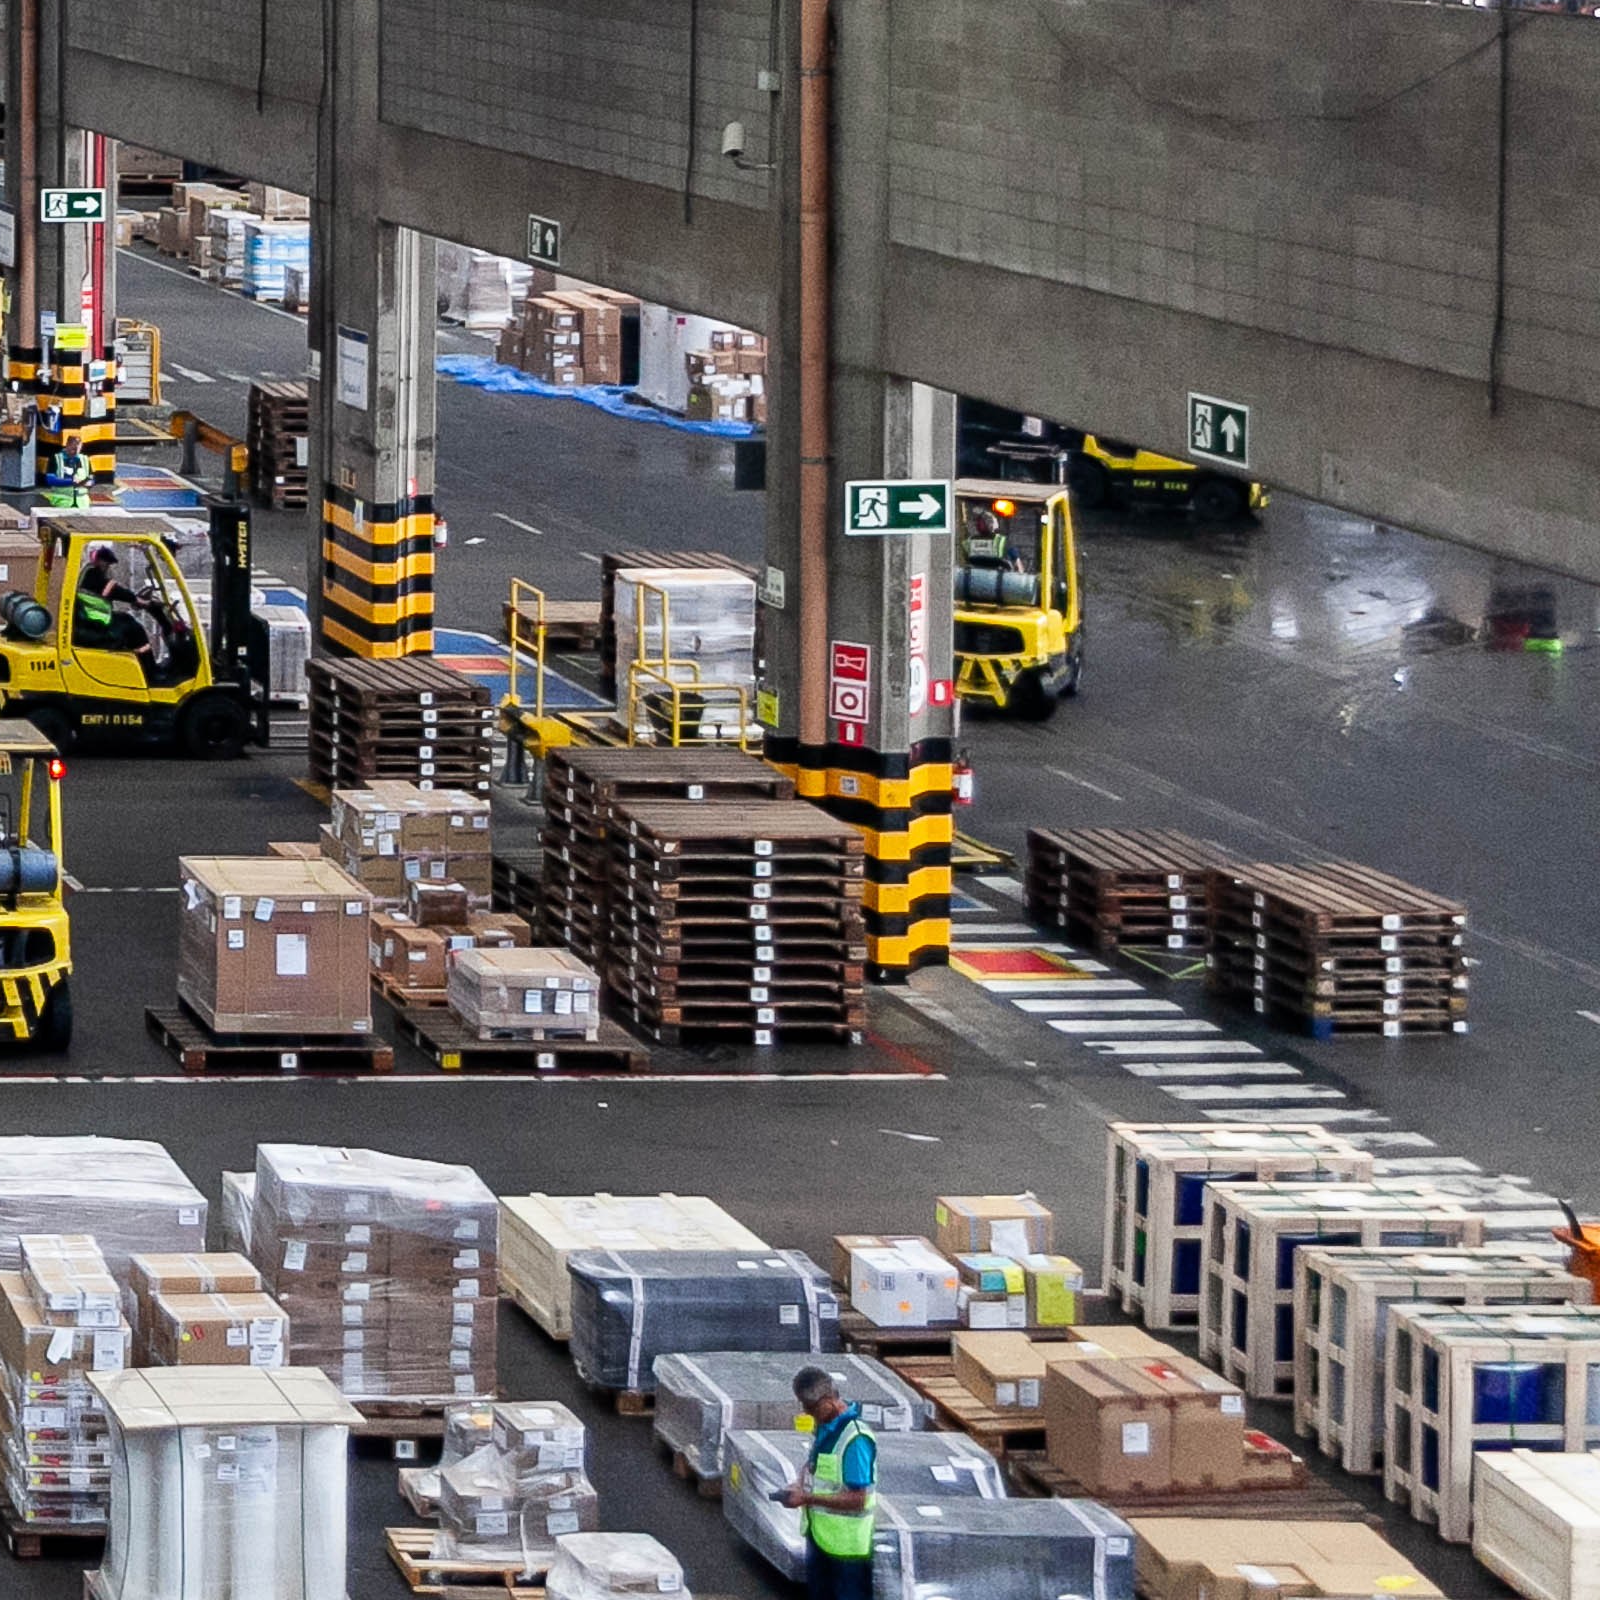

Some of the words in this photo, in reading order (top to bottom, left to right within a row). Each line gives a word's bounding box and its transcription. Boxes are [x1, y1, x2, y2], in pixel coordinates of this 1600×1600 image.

[237, 520, 248, 569] HYSTER
[30, 659, 56, 671] 1114
[112, 714, 143, 725] 0154
